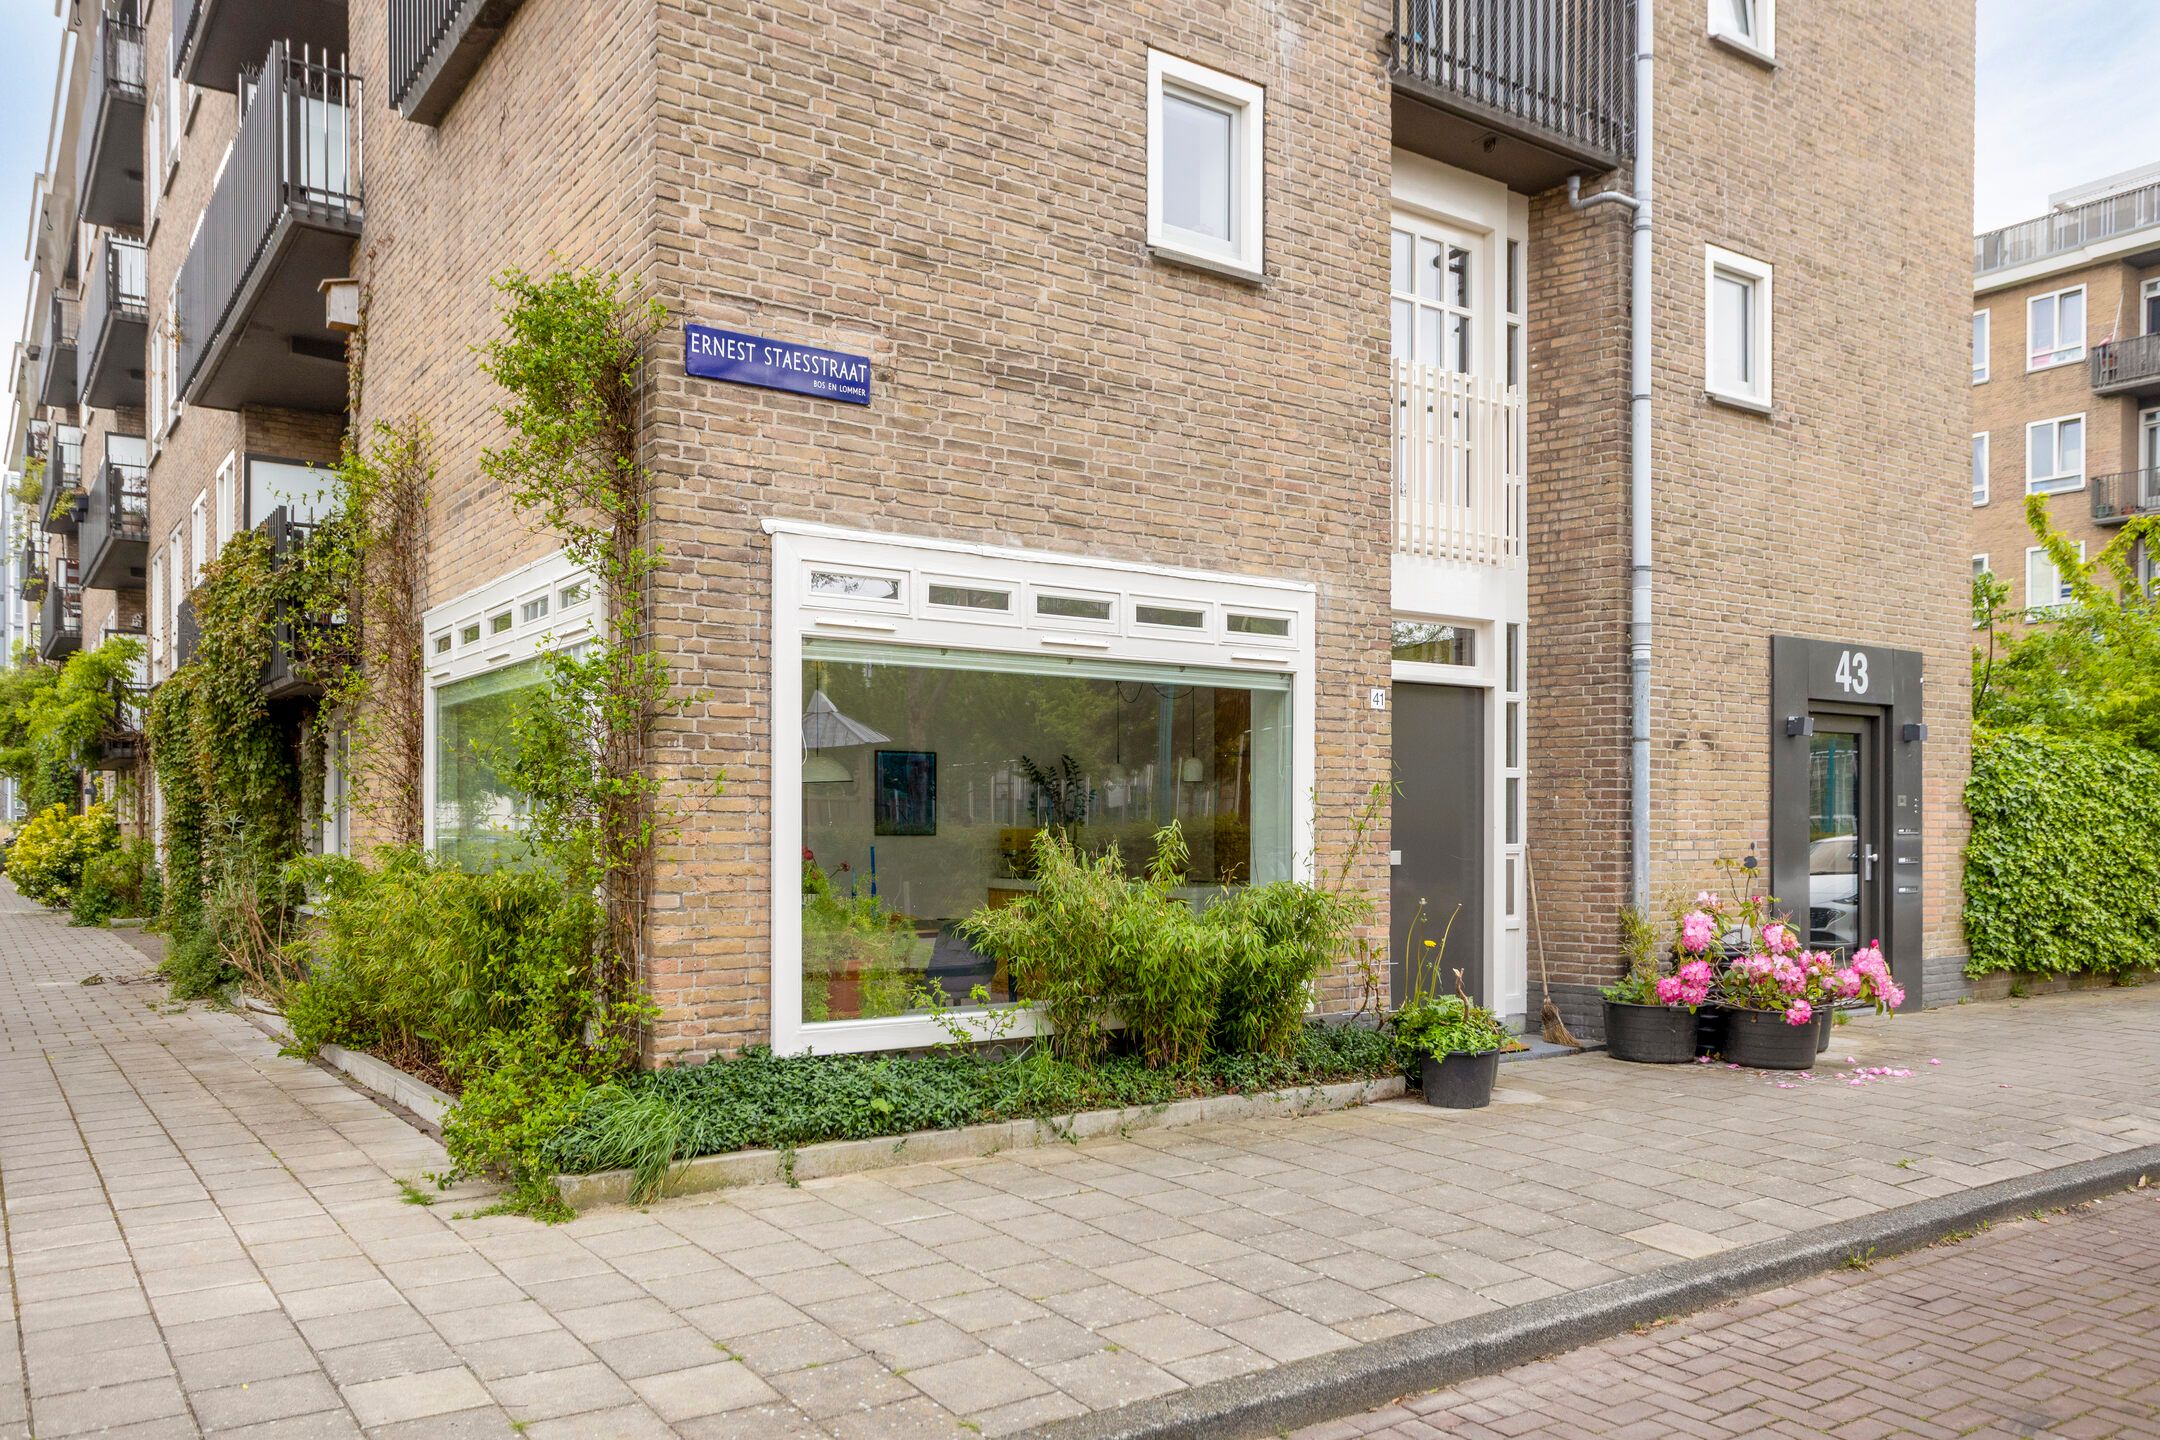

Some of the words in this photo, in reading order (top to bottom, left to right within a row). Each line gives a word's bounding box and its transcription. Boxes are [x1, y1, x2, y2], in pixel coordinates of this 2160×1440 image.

[691, 332, 756, 363] ERNEST
[764, 347, 868, 383] STAESSTRAAT
[813, 380, 826, 389] BOS
[828, 382, 837, 391] EN
[839, 385, 866, 397] LOMMER
[1835, 650, 1869, 695] 43
[1372, 692, 1384, 706] 41
